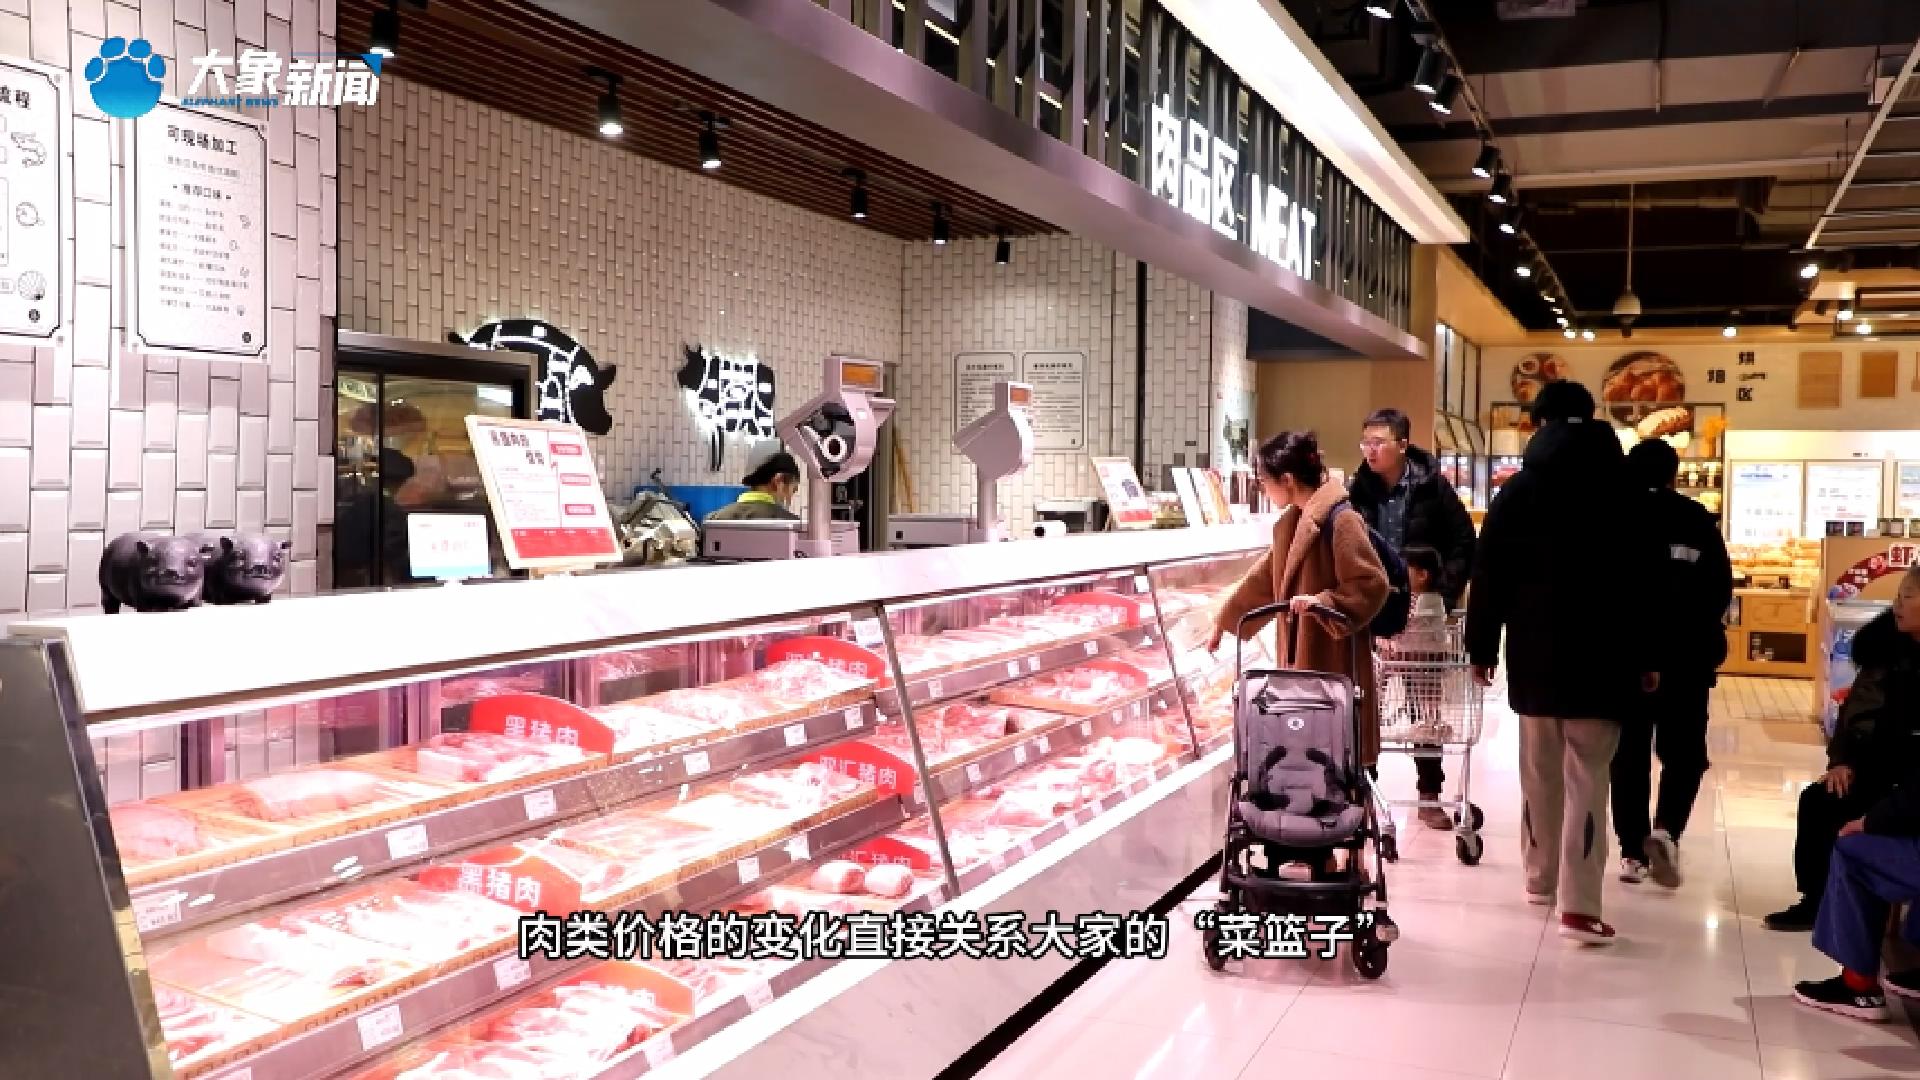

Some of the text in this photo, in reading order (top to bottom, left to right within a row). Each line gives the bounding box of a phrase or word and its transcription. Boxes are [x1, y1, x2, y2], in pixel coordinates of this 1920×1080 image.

[1151, 93, 1317, 280] 肉品区 MEAT
[459, 863, 541, 907] 黑猪肉
